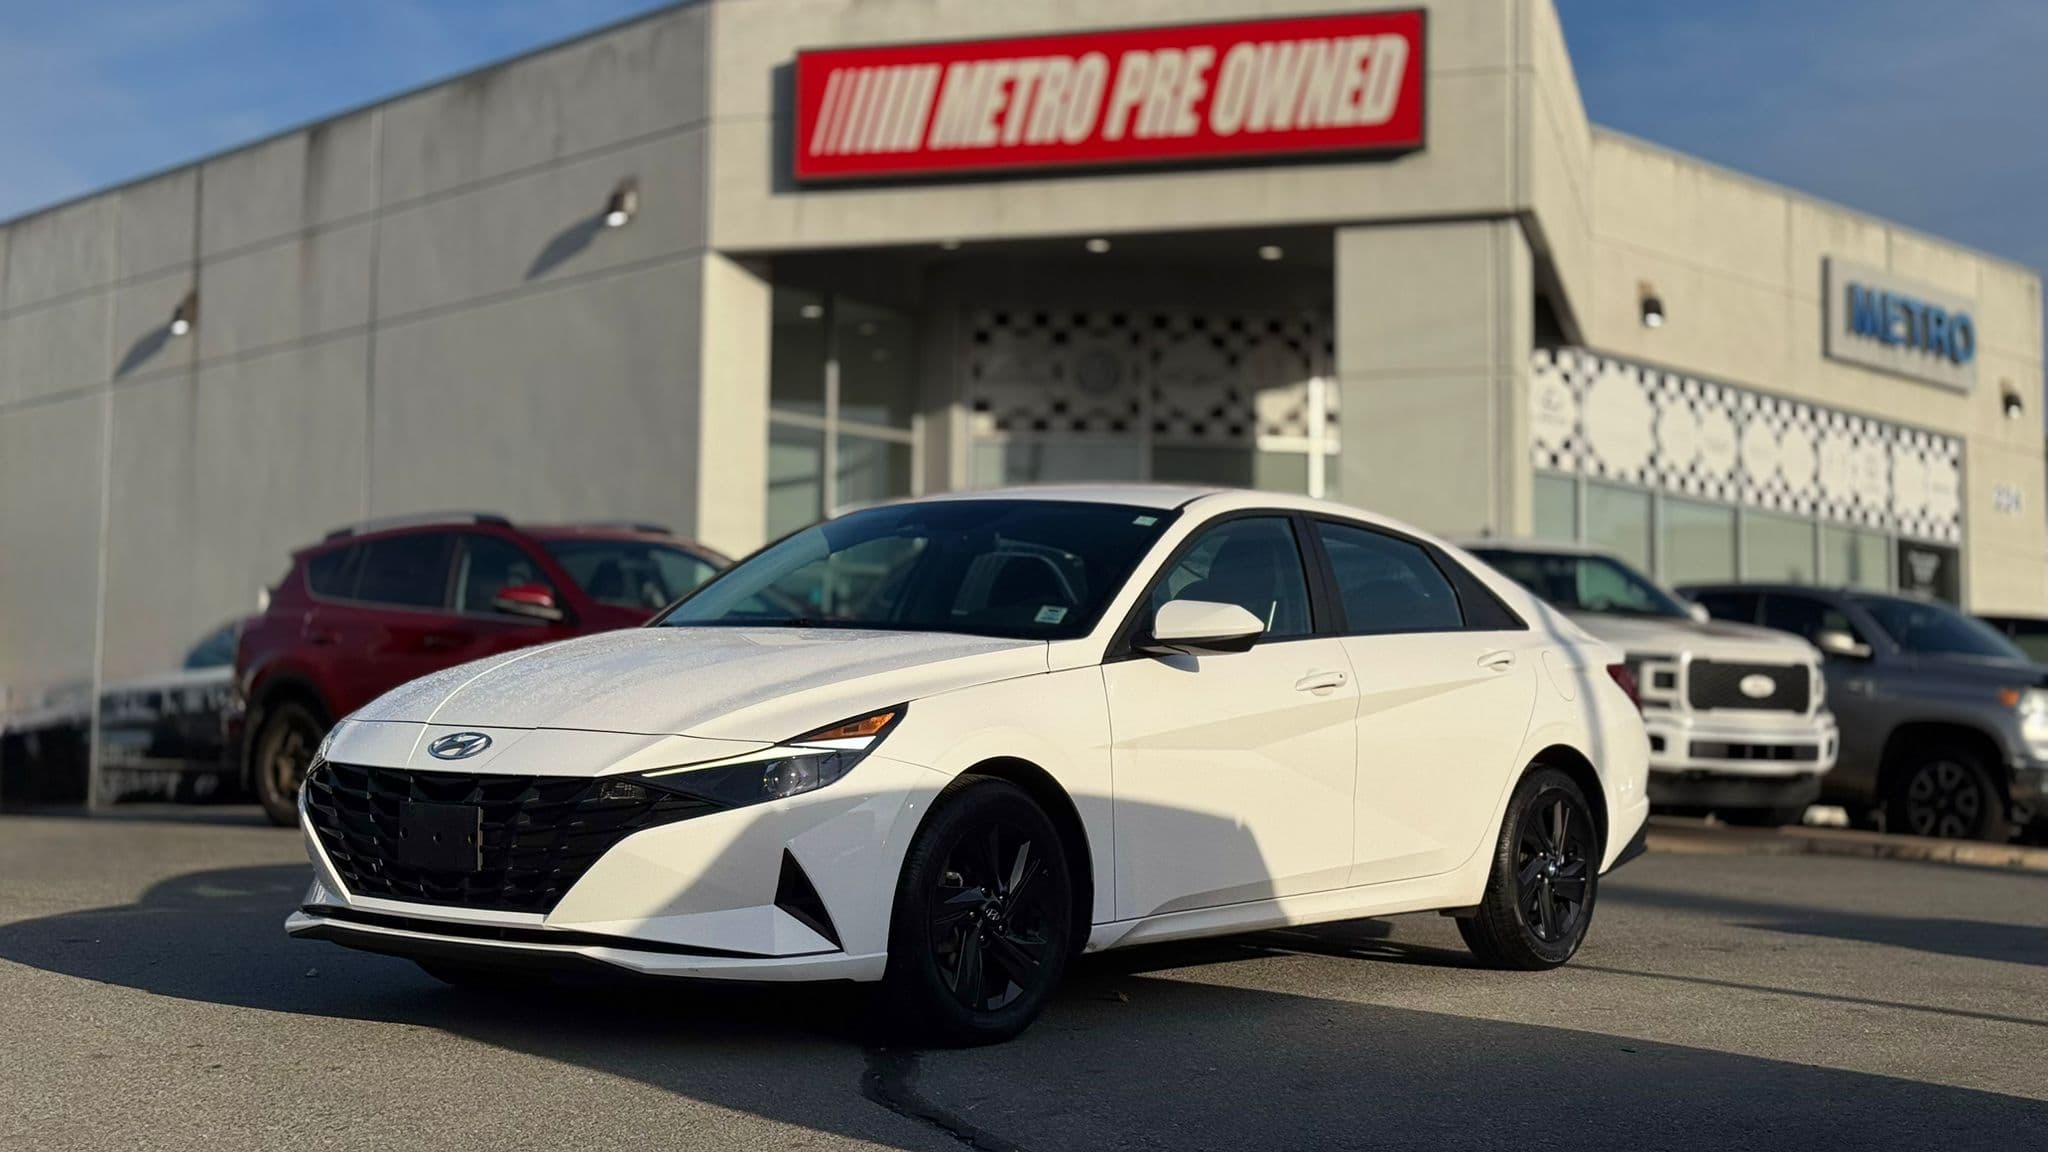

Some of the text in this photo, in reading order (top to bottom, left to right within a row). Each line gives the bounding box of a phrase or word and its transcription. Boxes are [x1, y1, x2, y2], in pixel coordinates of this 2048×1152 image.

[928, 35, 1408, 150] METRO PRE OWNED
[1847, 283, 1975, 363] METRO
